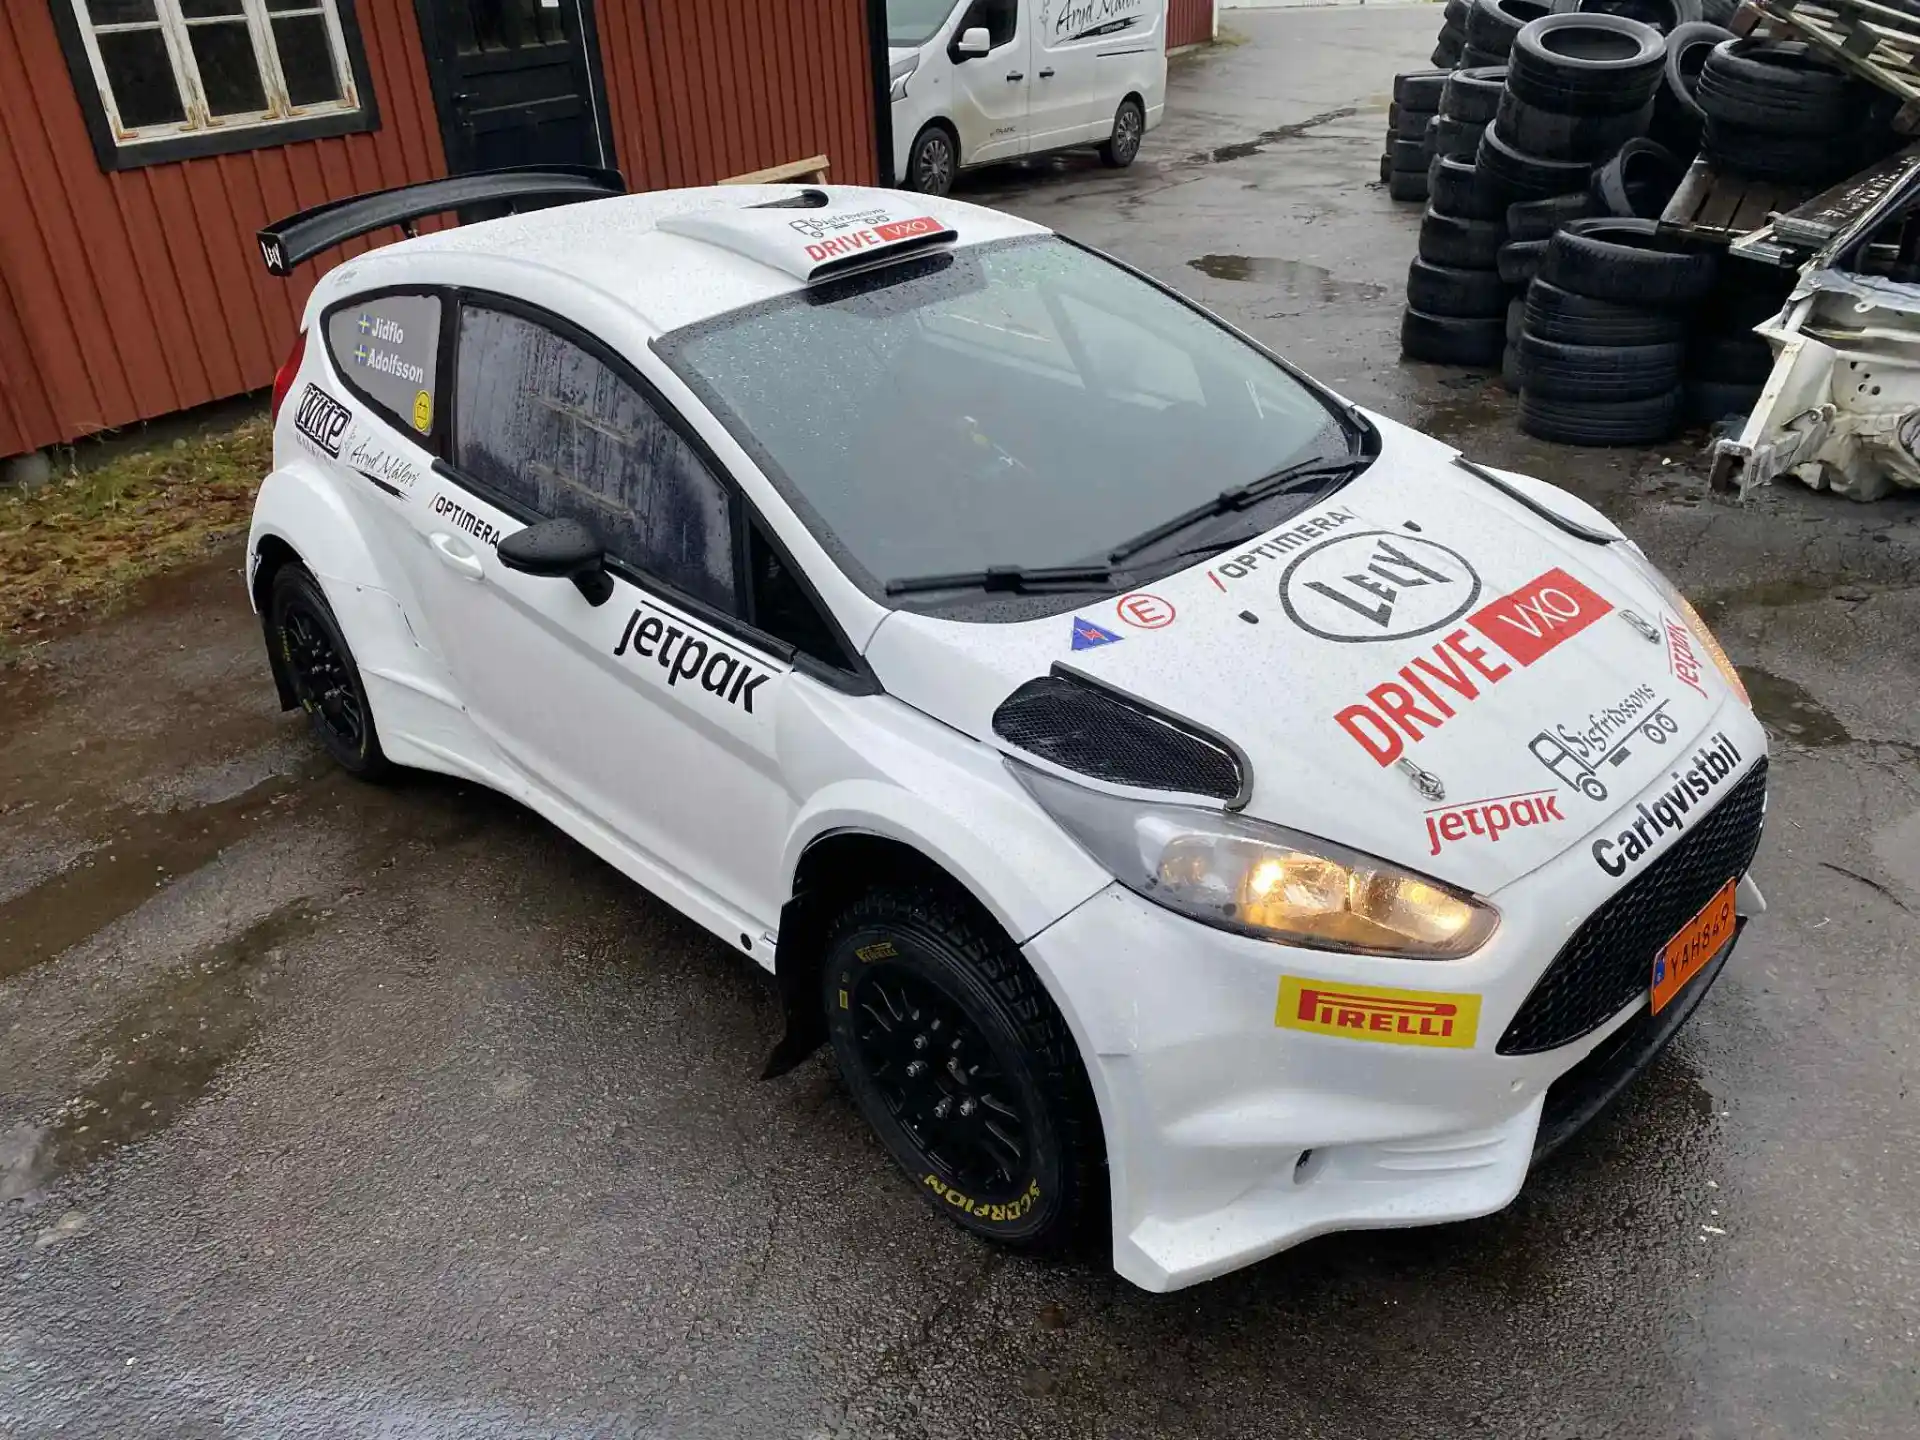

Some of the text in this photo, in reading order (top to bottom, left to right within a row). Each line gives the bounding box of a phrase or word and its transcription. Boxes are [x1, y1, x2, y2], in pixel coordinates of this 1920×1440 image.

[804, 220, 928, 262] DRIVE VXO
[366, 347, 424, 384] Adolfsson
[1302, 538, 1454, 628] LELY
[613, 606, 772, 715] jetpak
[1333, 587, 1581, 768] DRIVE VXO
[1556, 683, 1656, 758] Sigfridssons
[1425, 794, 1566, 856] jetpak
[1591, 731, 1743, 878] Carlqvistbil
[1298, 988, 1458, 1038] PIRELLI
[923, 1174, 1041, 1222] SCORPION
